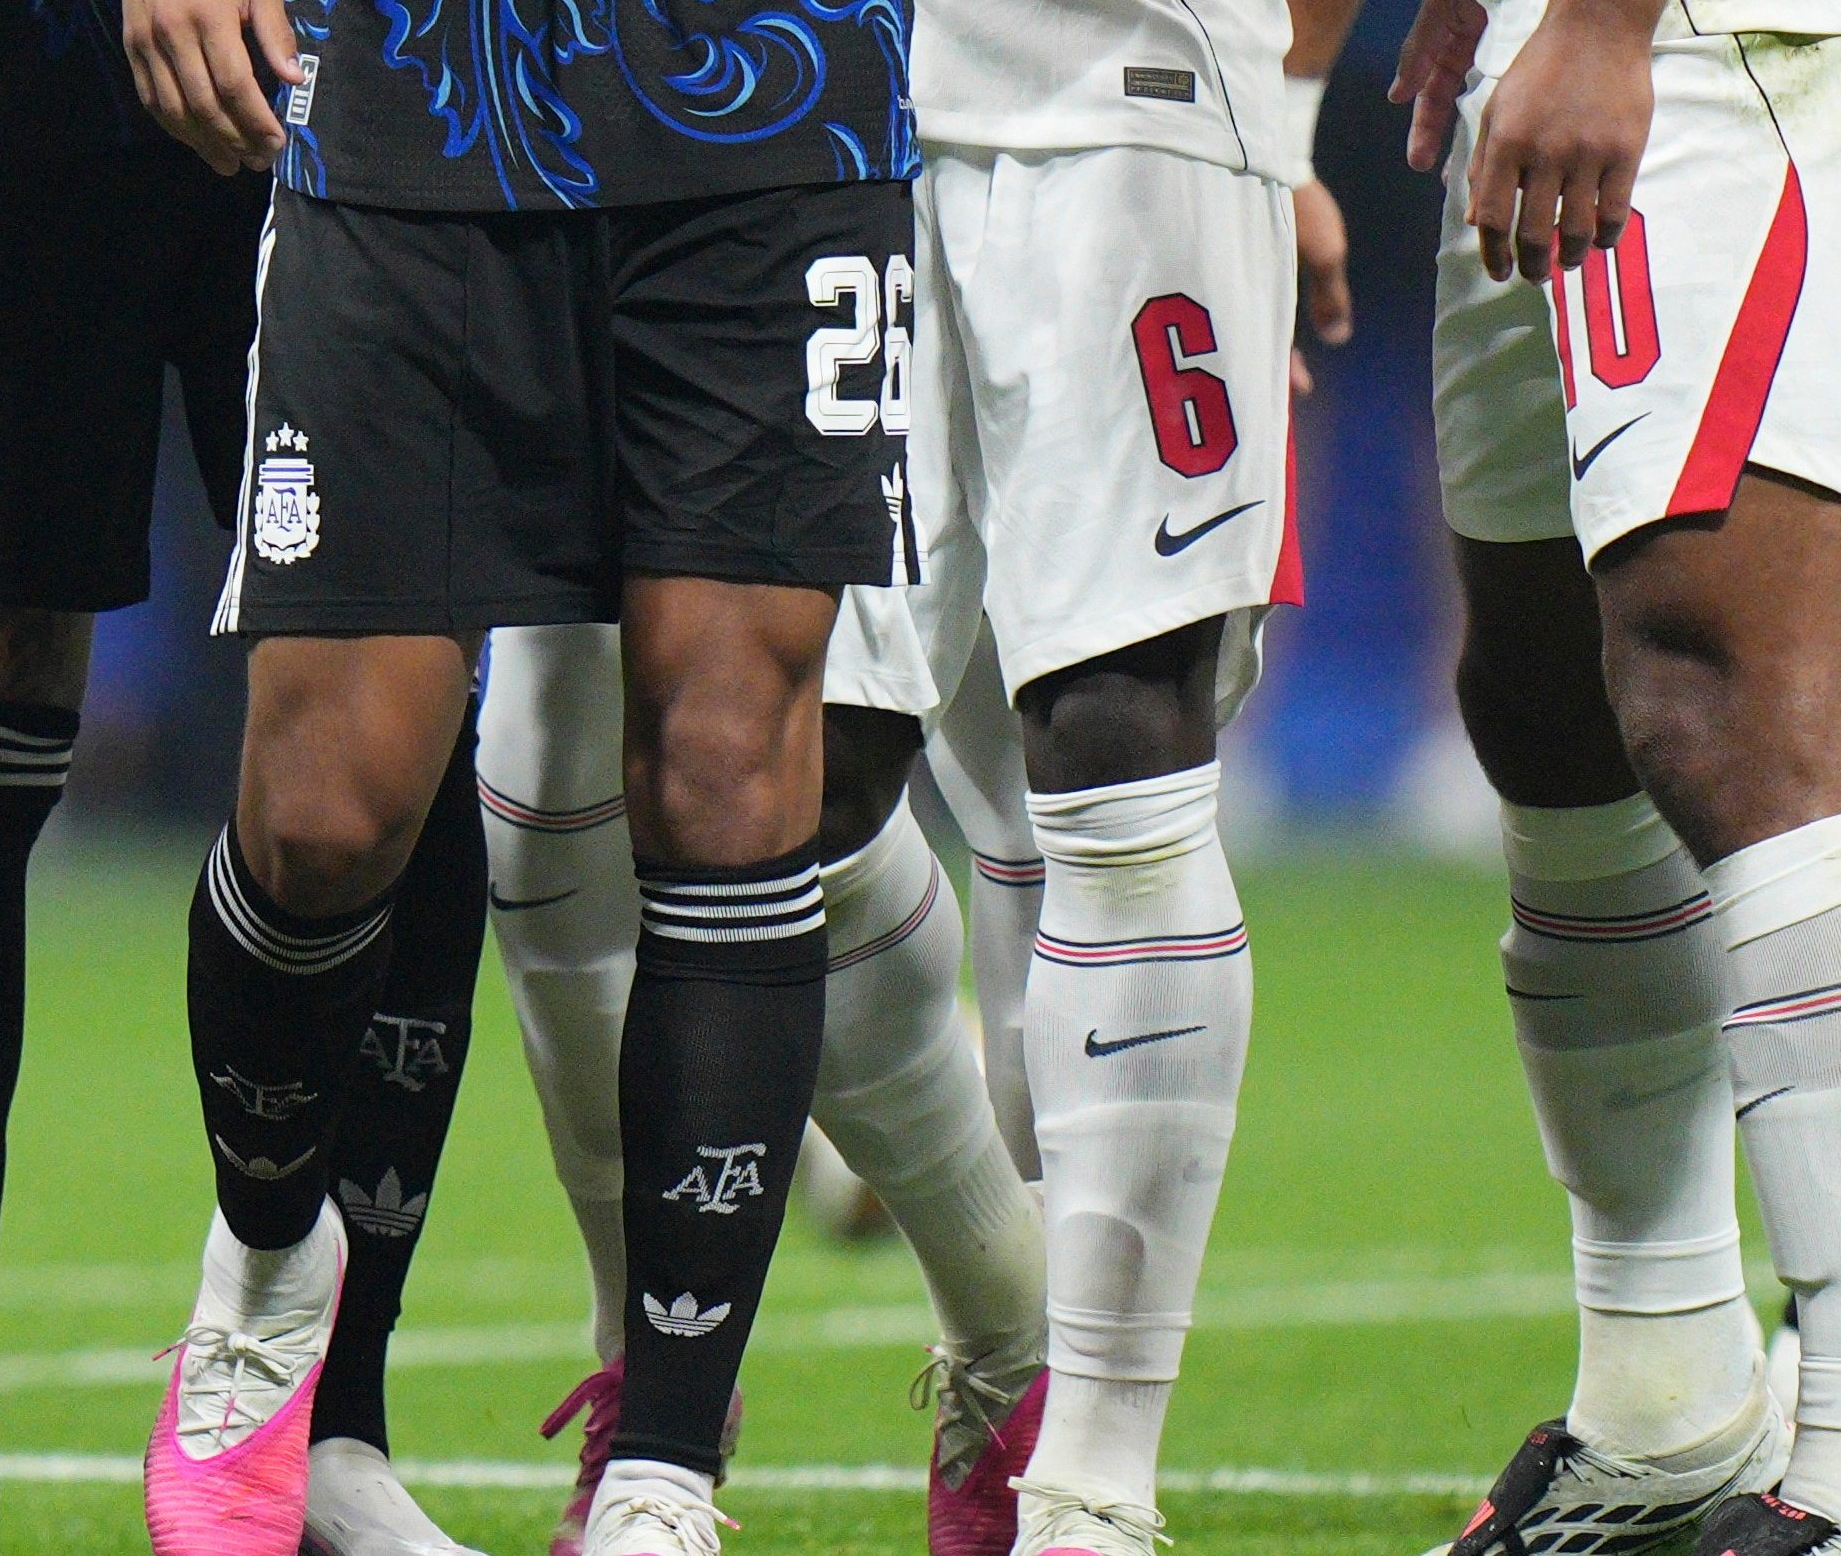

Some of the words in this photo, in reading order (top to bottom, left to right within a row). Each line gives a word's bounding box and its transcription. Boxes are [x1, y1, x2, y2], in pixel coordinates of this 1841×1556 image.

[805, 255, 914, 436] 26
[1131, 291, 1238, 479] 6
[266, 486, 303, 533] AFA
[361, 1011, 449, 1092] AFA
[662, 1143, 768, 1215] AFA
